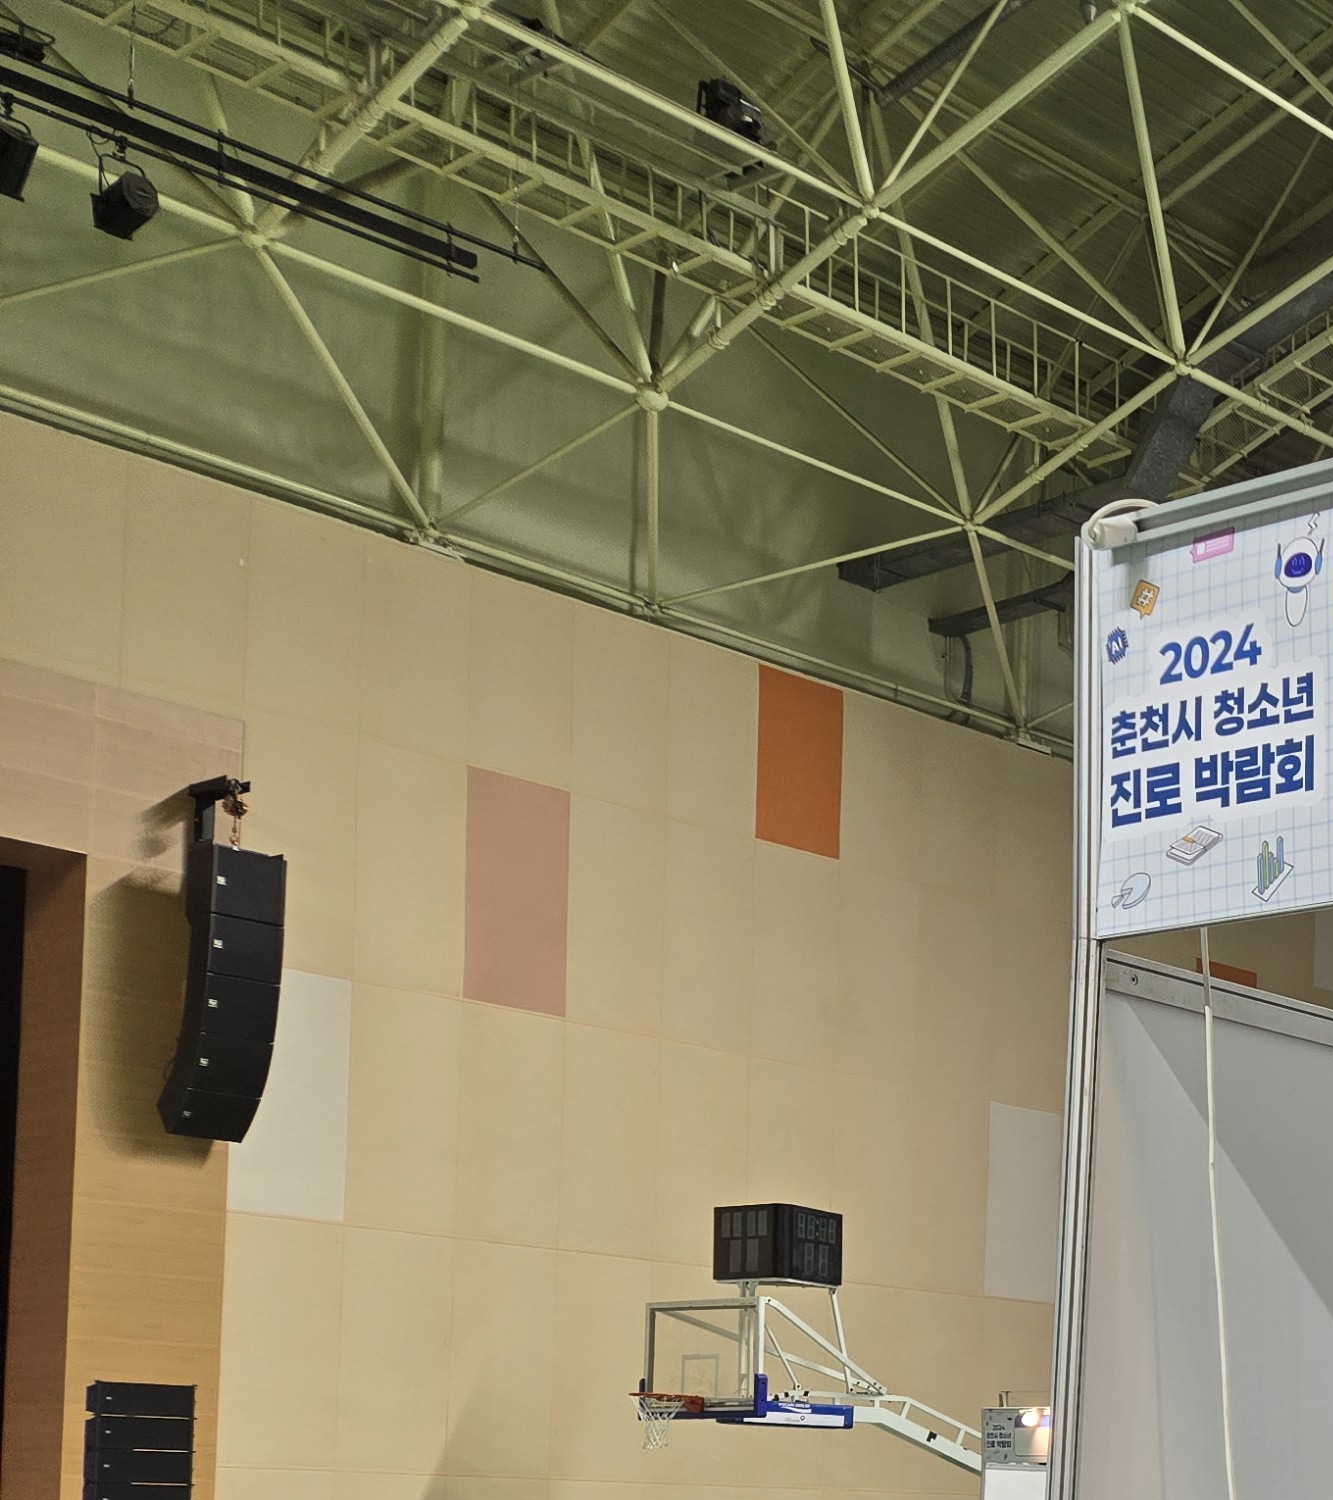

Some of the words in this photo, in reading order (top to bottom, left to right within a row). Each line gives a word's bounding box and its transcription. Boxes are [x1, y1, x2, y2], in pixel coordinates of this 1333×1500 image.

[1158, 622, 1263, 686] 2024
[1110, 696, 1202, 760] 춘천시
[1213, 672, 1315, 737] 청소년
[1110, 761, 1182, 829] 진로
[1194, 735, 1315, 808] 박람회
